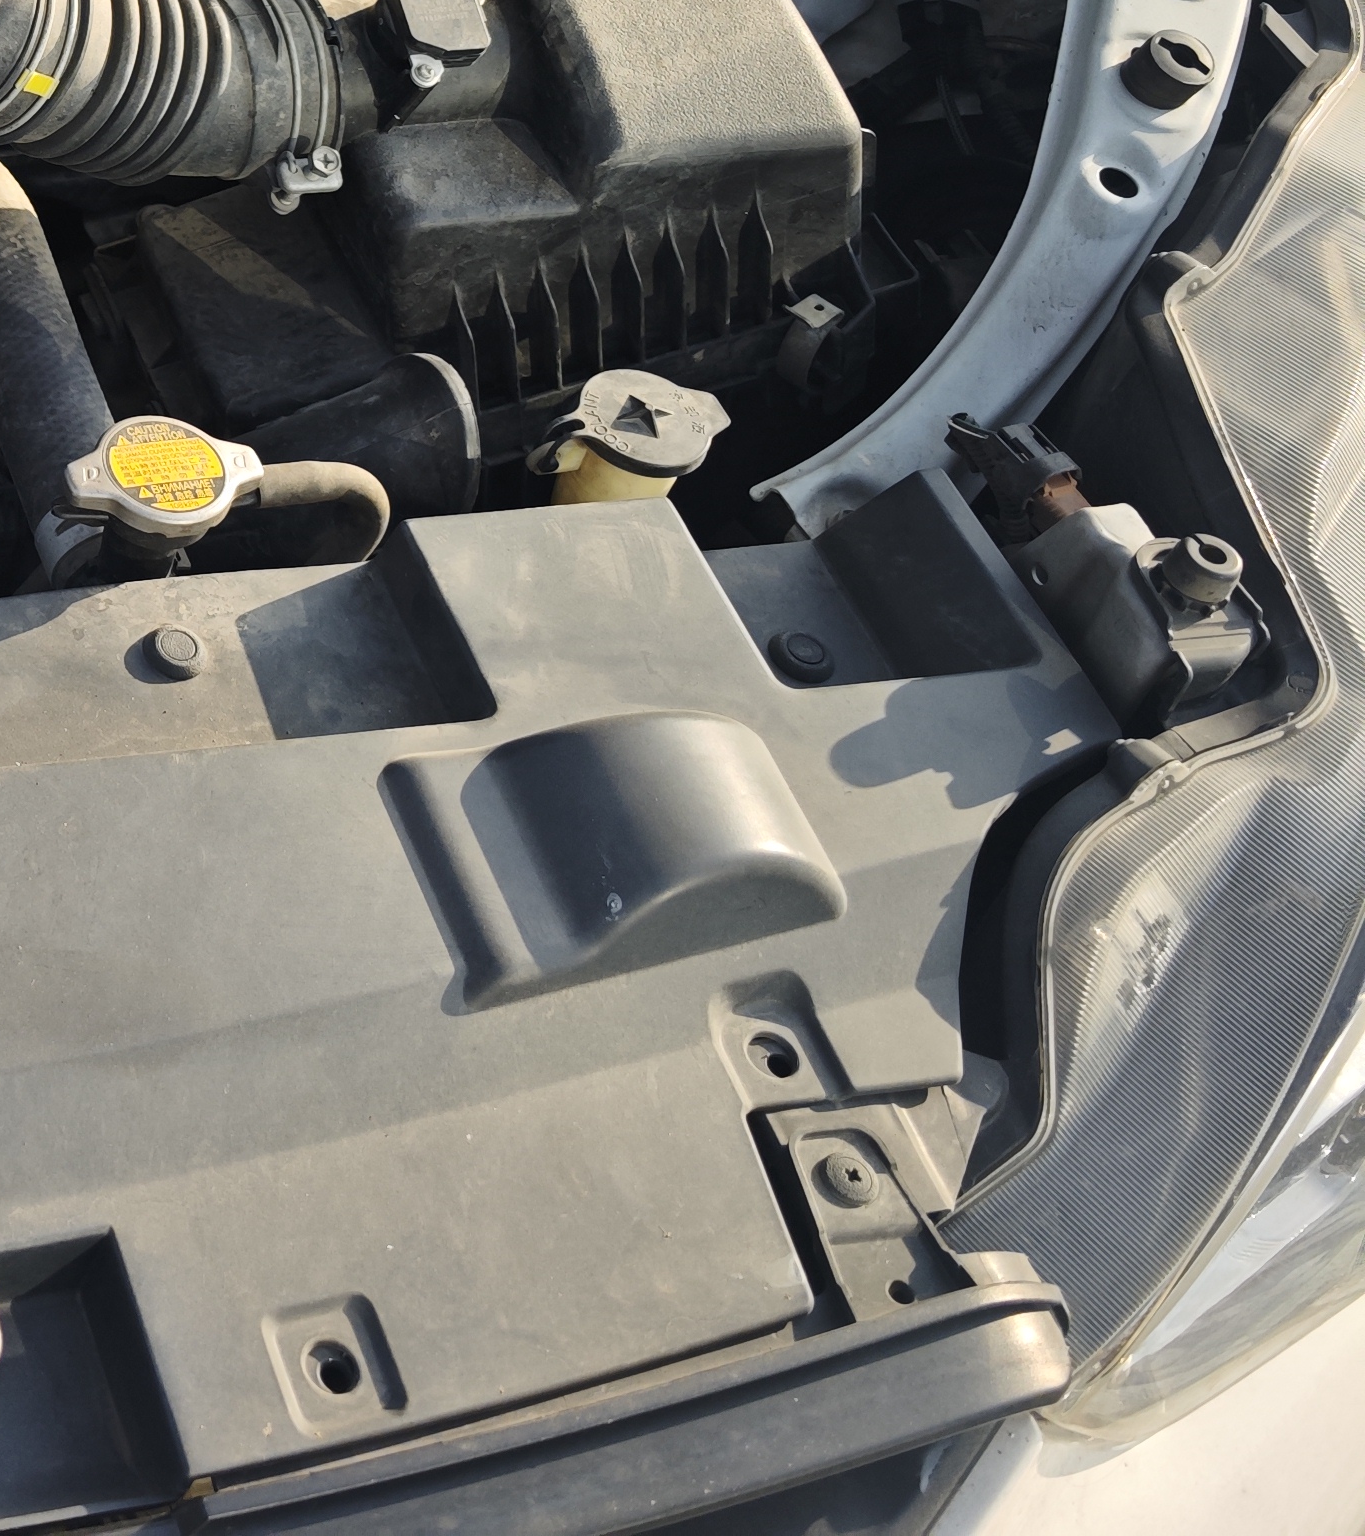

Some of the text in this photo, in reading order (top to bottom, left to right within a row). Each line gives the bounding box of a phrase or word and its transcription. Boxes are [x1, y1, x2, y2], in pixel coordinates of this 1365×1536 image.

[126, 423, 171, 436] CAUTION
[131, 429, 187, 444] ATTENTION
[151, 479, 216, 494] ВНИМАНИЕ!
